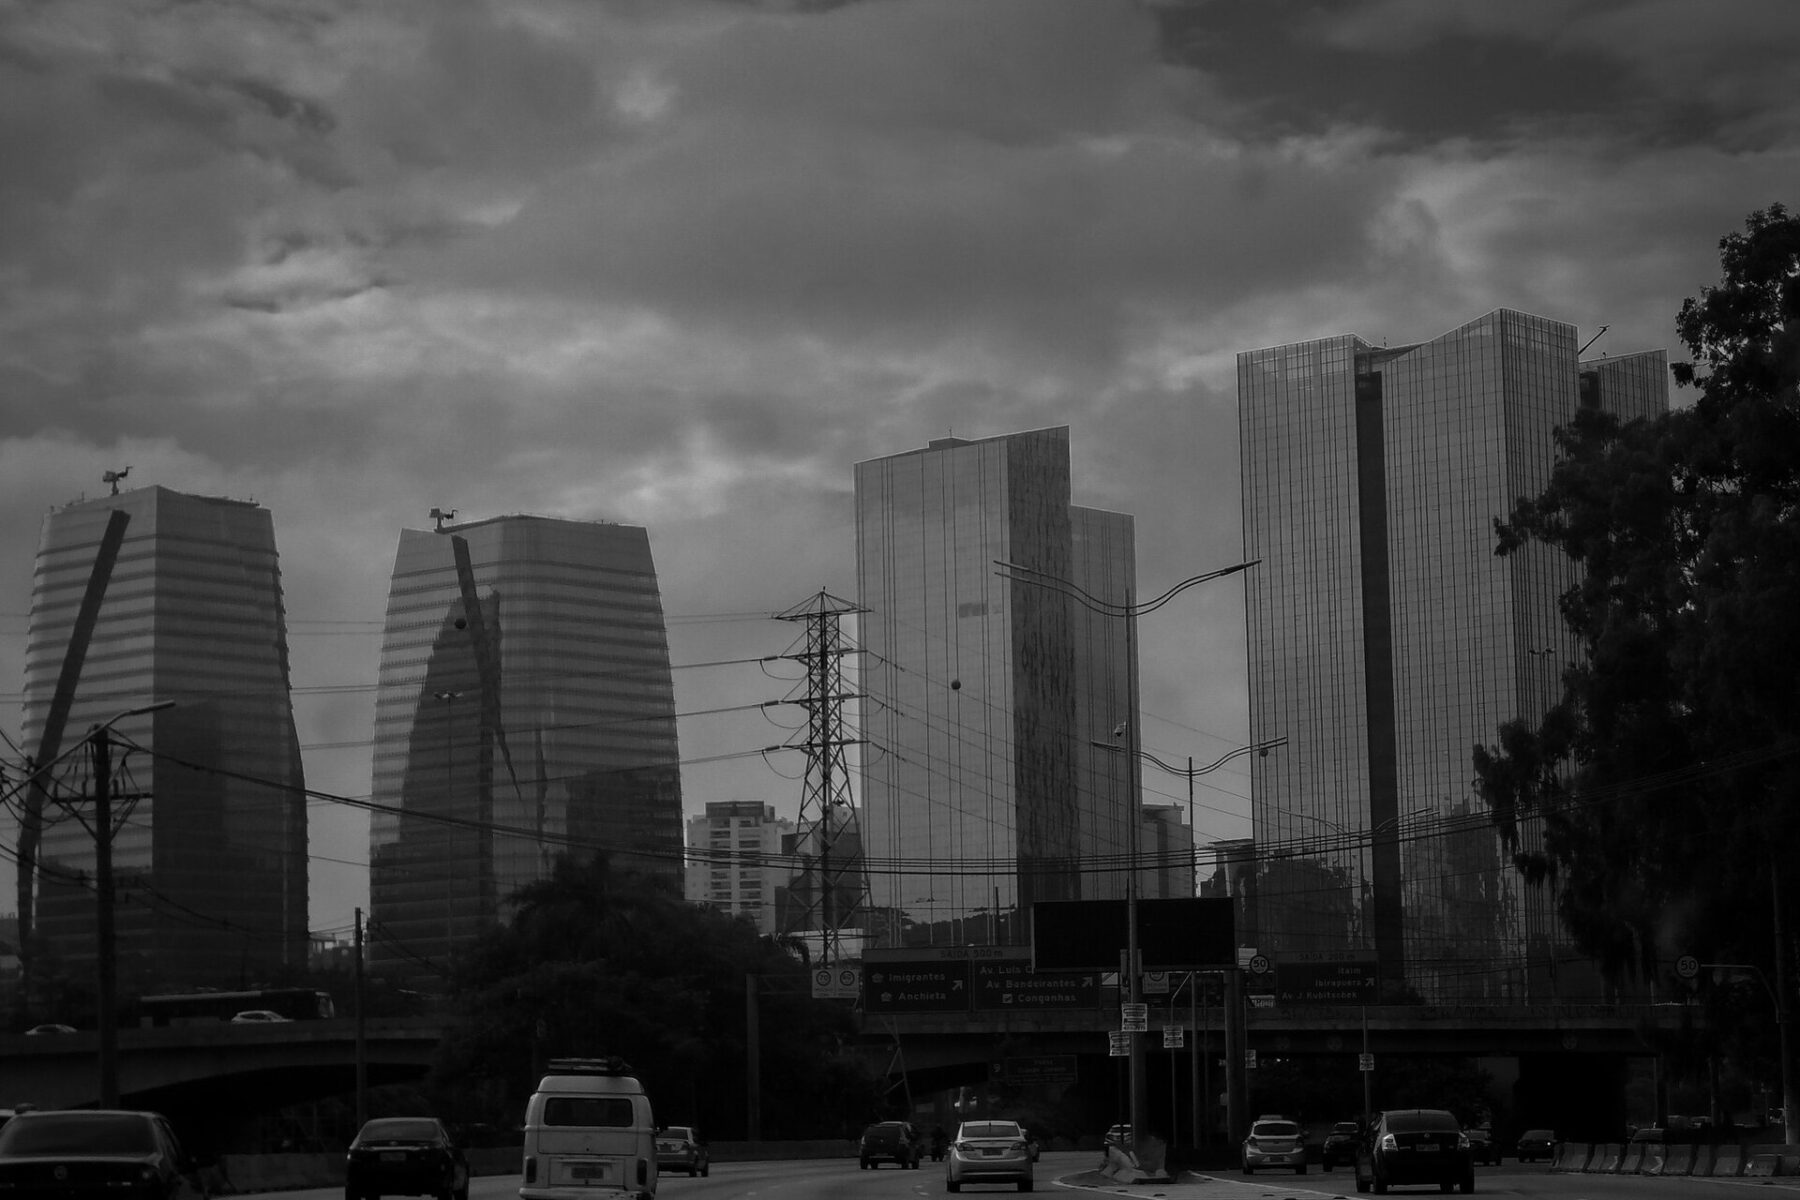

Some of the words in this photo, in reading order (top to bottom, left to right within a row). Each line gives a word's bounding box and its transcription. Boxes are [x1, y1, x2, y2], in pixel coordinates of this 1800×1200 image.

[1254, 959, 1266, 968] 50
[1681, 960, 1697, 971] 50
[888, 973, 946, 984] Imigrantes
[1005, 979, 1077, 989] Bandeirantes
[898, 991, 947, 1001] Anchieta
[1017, 993, 1077, 1004] Congonhas
